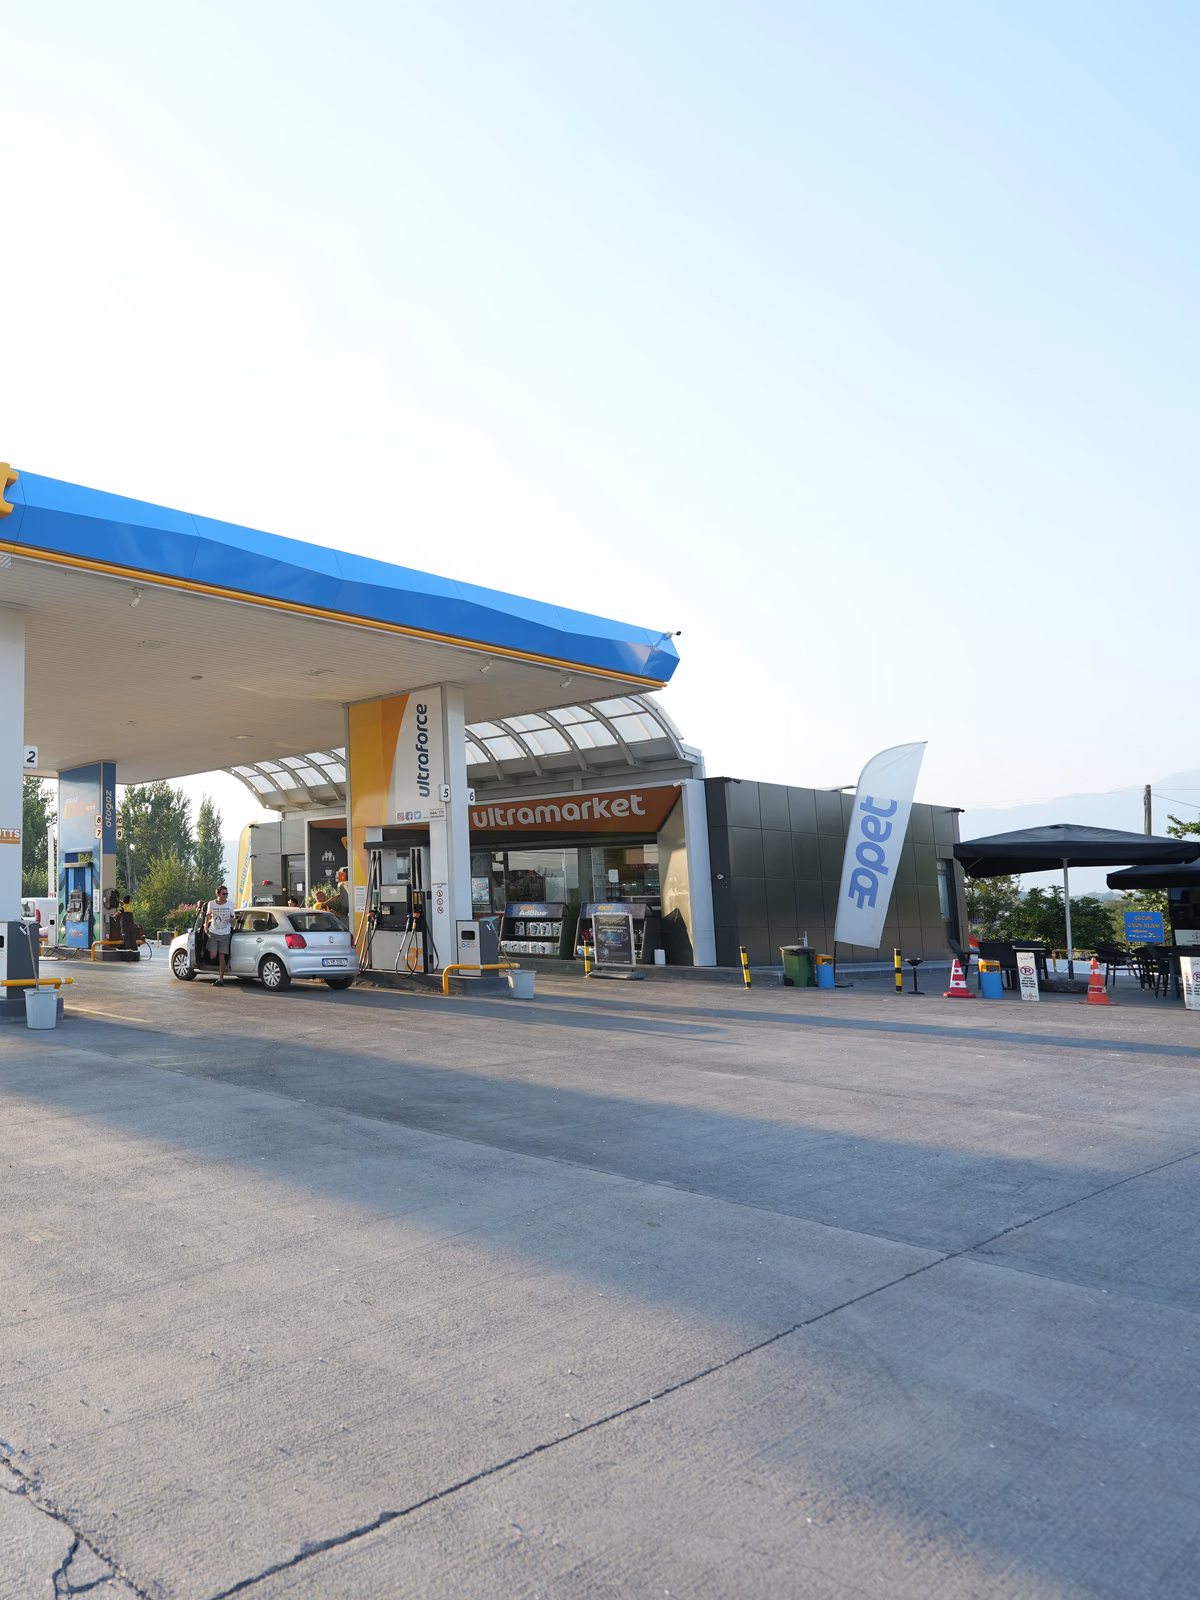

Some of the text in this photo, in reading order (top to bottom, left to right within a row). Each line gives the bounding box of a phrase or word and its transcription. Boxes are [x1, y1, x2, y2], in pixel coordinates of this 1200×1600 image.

[26, 751, 36, 763] 2
[416, 704, 430, 797] ultraforce
[105, 790, 113, 828] otogaz
[443, 789, 448, 797] 5
[470, 792, 474, 801] 6
[472, 794, 645, 828] ultramarket
[848, 795, 897, 909] opet
